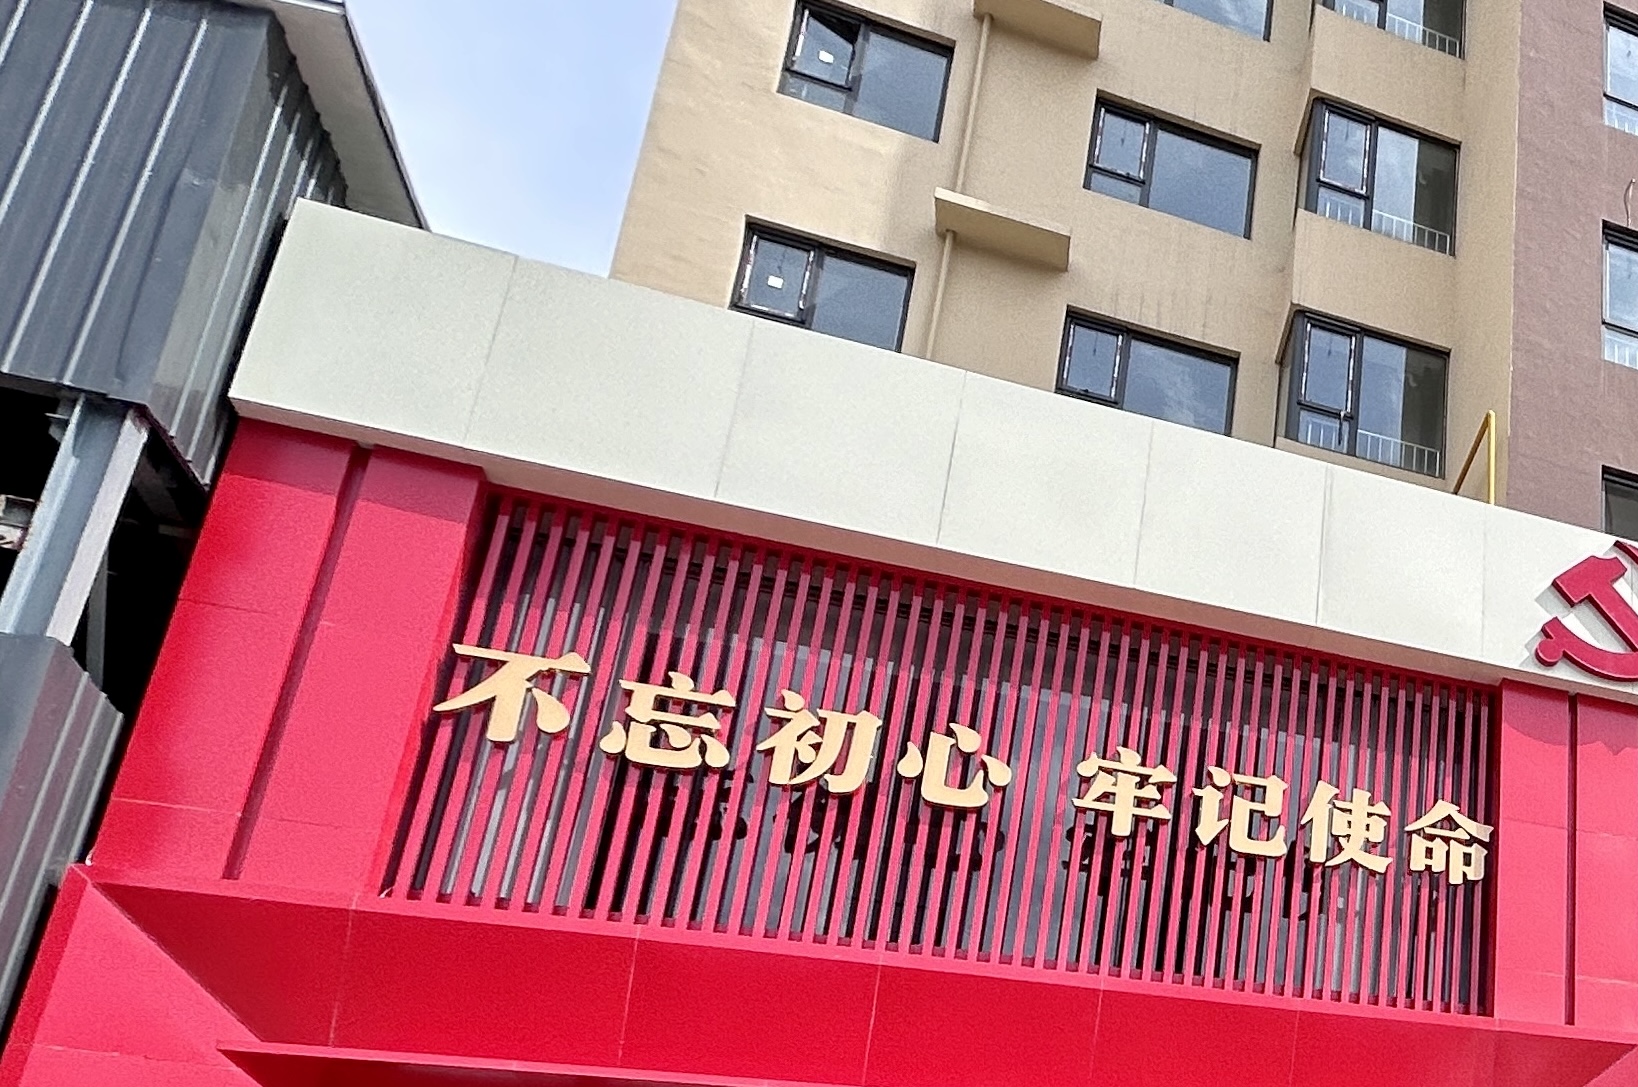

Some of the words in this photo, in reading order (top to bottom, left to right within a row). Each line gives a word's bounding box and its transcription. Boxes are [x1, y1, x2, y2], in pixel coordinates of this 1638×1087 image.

[432, 643, 1012, 810] 不忘初心
[1072, 745, 1495, 885] 牢记使命
